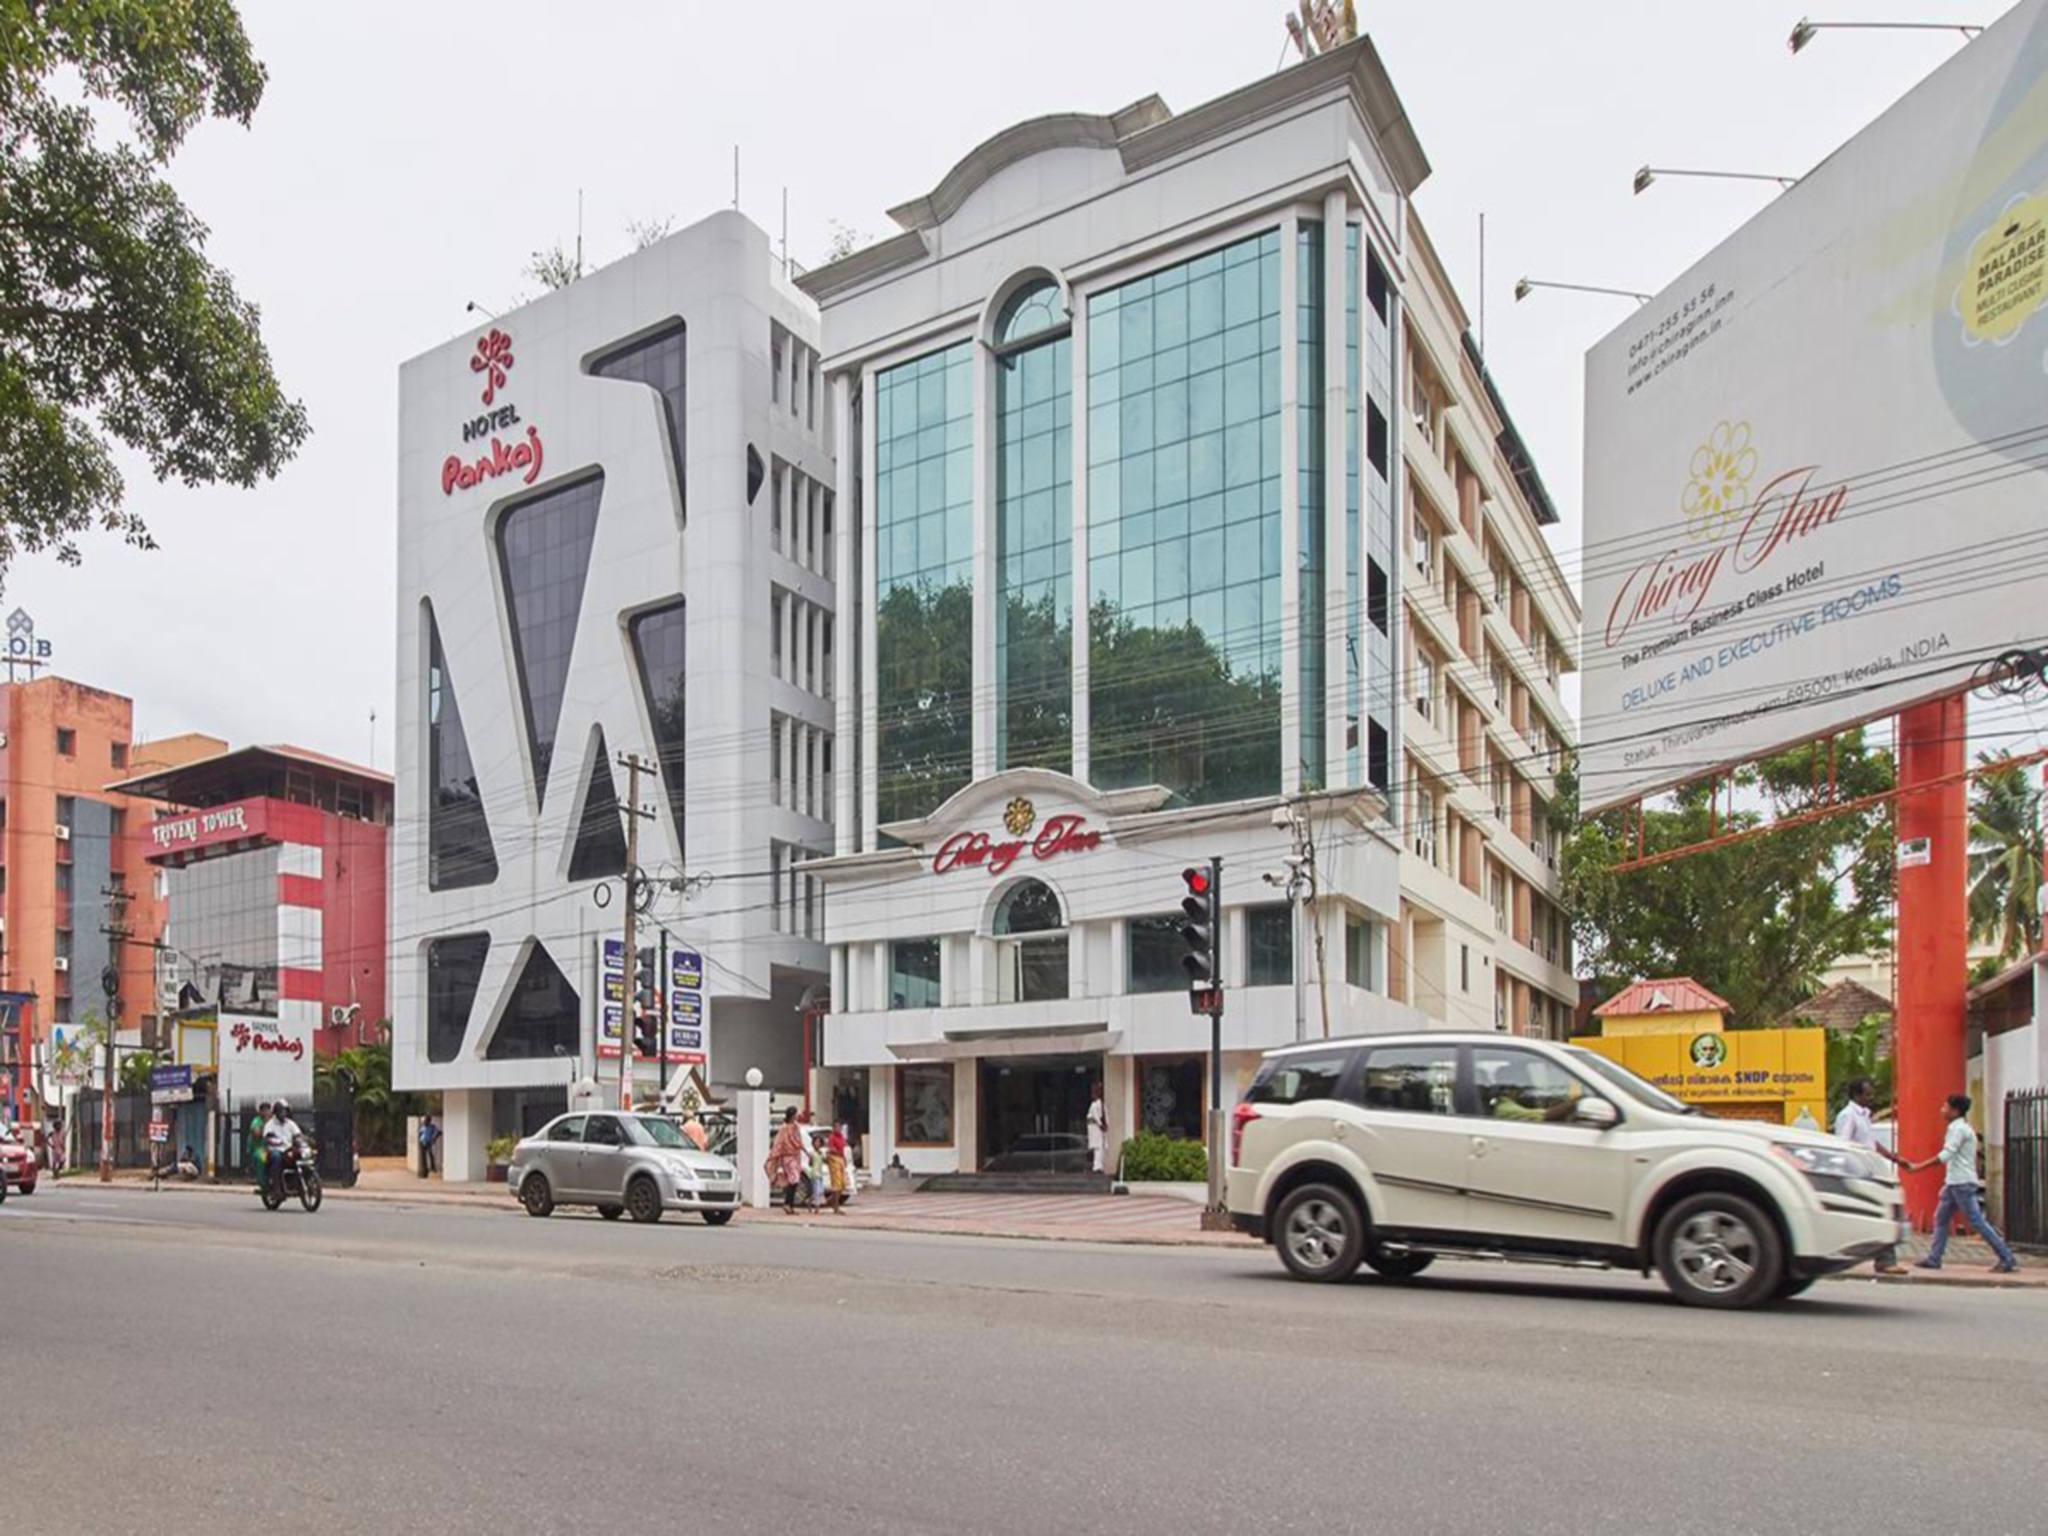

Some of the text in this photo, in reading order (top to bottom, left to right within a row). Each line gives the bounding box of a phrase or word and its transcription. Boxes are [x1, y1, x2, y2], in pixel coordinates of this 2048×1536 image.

[1976, 245, 2045, 296] PARADISE
[1979, 228, 2046, 281] MALABAR
[463, 403, 521, 442] HOTEL
[442, 425, 543, 496] Pankaj
[1605, 465, 1848, 649] Chirag Inn
[1621, 560, 1825, 670] The Premium Business Class Hotel
[1621, 573, 1902, 711] DELUXE AND EXECUTIVE ROOMS
[1901, 632, 1950, 667] INDIA
[201, 806, 248, 833] TOWER
[933, 814, 1101, 875] Chirag Inn
[253, 1033, 304, 1061] Pankaj
[1734, 1070, 1769, 1084] SNDP
